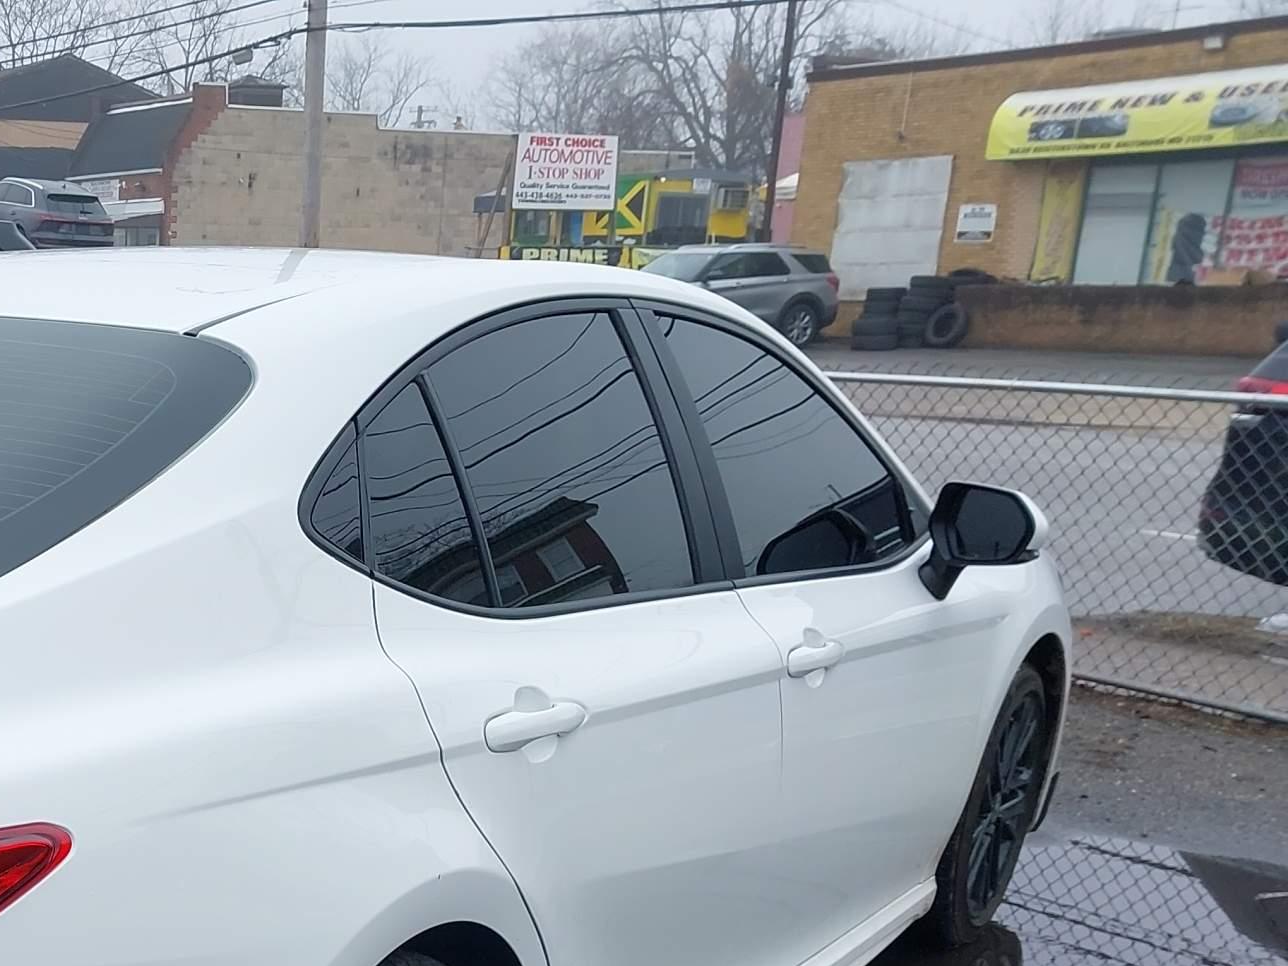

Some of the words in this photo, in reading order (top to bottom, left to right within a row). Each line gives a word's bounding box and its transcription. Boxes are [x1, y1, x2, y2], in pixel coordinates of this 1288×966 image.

[1017, 100, 1105, 117] PRIME
[1111, 92, 1178, 109] NEW
[529, 136, 561, 147] FIRST
[564, 136, 607, 148] CHOICE
[521, 148, 613, 165] AUTOMOTIVE
[572, 167, 605, 180] SHOP
[519, 181, 544, 190] Quality
[545, 181, 570, 189] Service
[522, 248, 608, 265] PRIME
